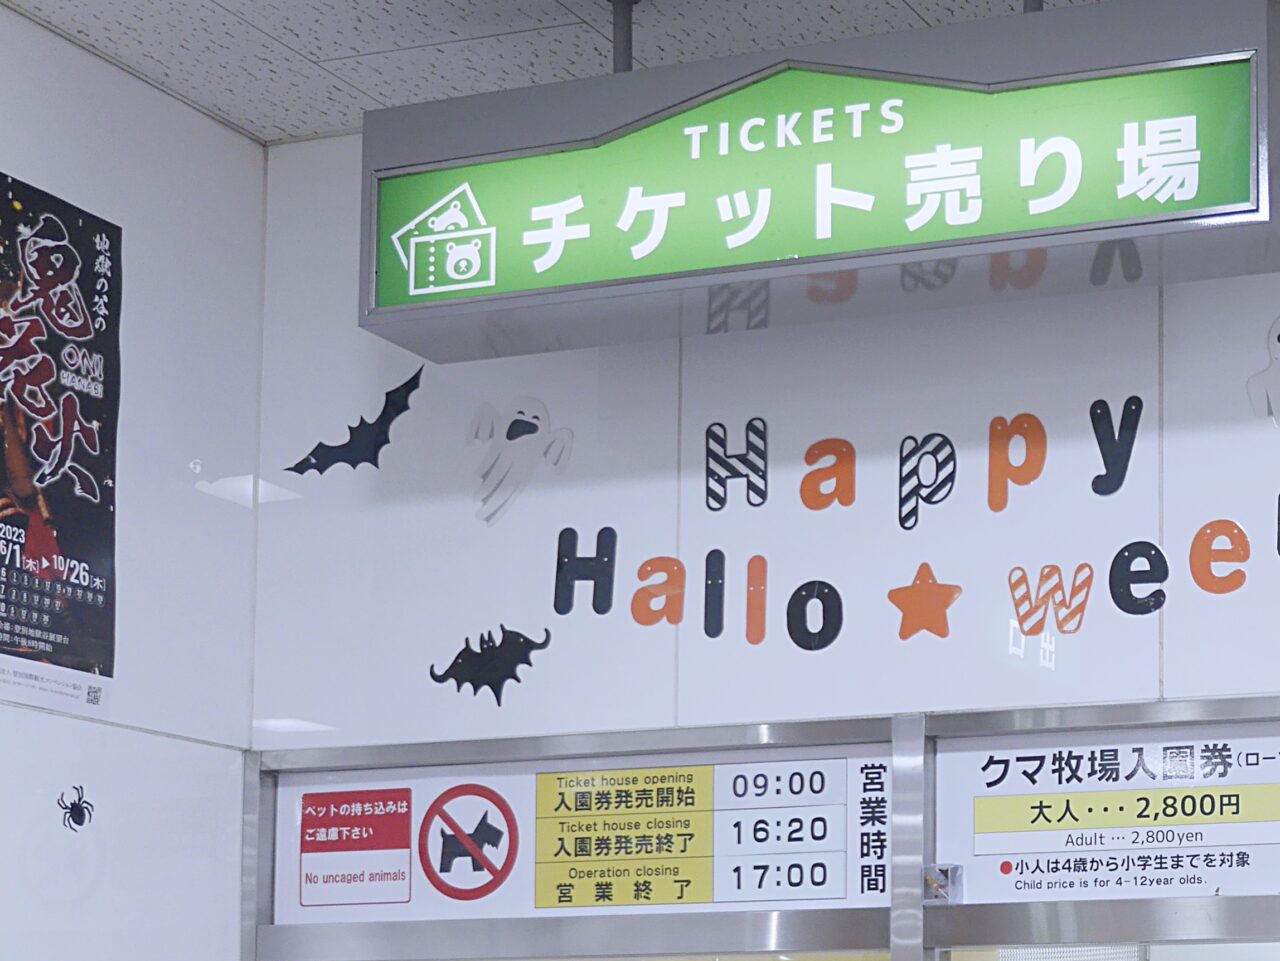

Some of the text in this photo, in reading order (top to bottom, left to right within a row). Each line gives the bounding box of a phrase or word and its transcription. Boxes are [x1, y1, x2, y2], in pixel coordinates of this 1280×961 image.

[684, 98, 905, 160] TICKETS
[522, 115, 1202, 274] チケット売り場
[705, 395, 1144, 531] Happy
[0, 523, 26, 544] 2023
[980, 742, 1234, 789] クマ牧場入園券
[557, 772, 693, 788] Ticket house opening
[732, 770, 826, 798] 09:00
[305, 800, 409, 817] ペットの持ち込みは
[553, 786, 696, 812] 入園券発売開始
[304, 826, 374, 842] ご遠慮下さい
[558, 817, 691, 833] Ticket house closing
[732, 816, 828, 845] 16:20
[859, 763, 888, 894] 営業時間
[553, 833, 695, 858] 入園券発売終了
[1065, 832, 1105, 847] Adult
[568, 864, 680, 880] Operation closing
[1014, 851, 1251, 875] 小人は4歳から小学生までを対象
[305, 869, 406, 885] No uncaged animals
[732, 862, 828, 890] 17:00
[1014, 879, 1042, 891] Child
[1047, 879, 1075, 890] price
[1079, 878, 1089, 889] is
[1093, 877, 1110, 888] for
[1179, 874, 1207, 885] olds.
[556, 879, 692, 903] 営業終了
